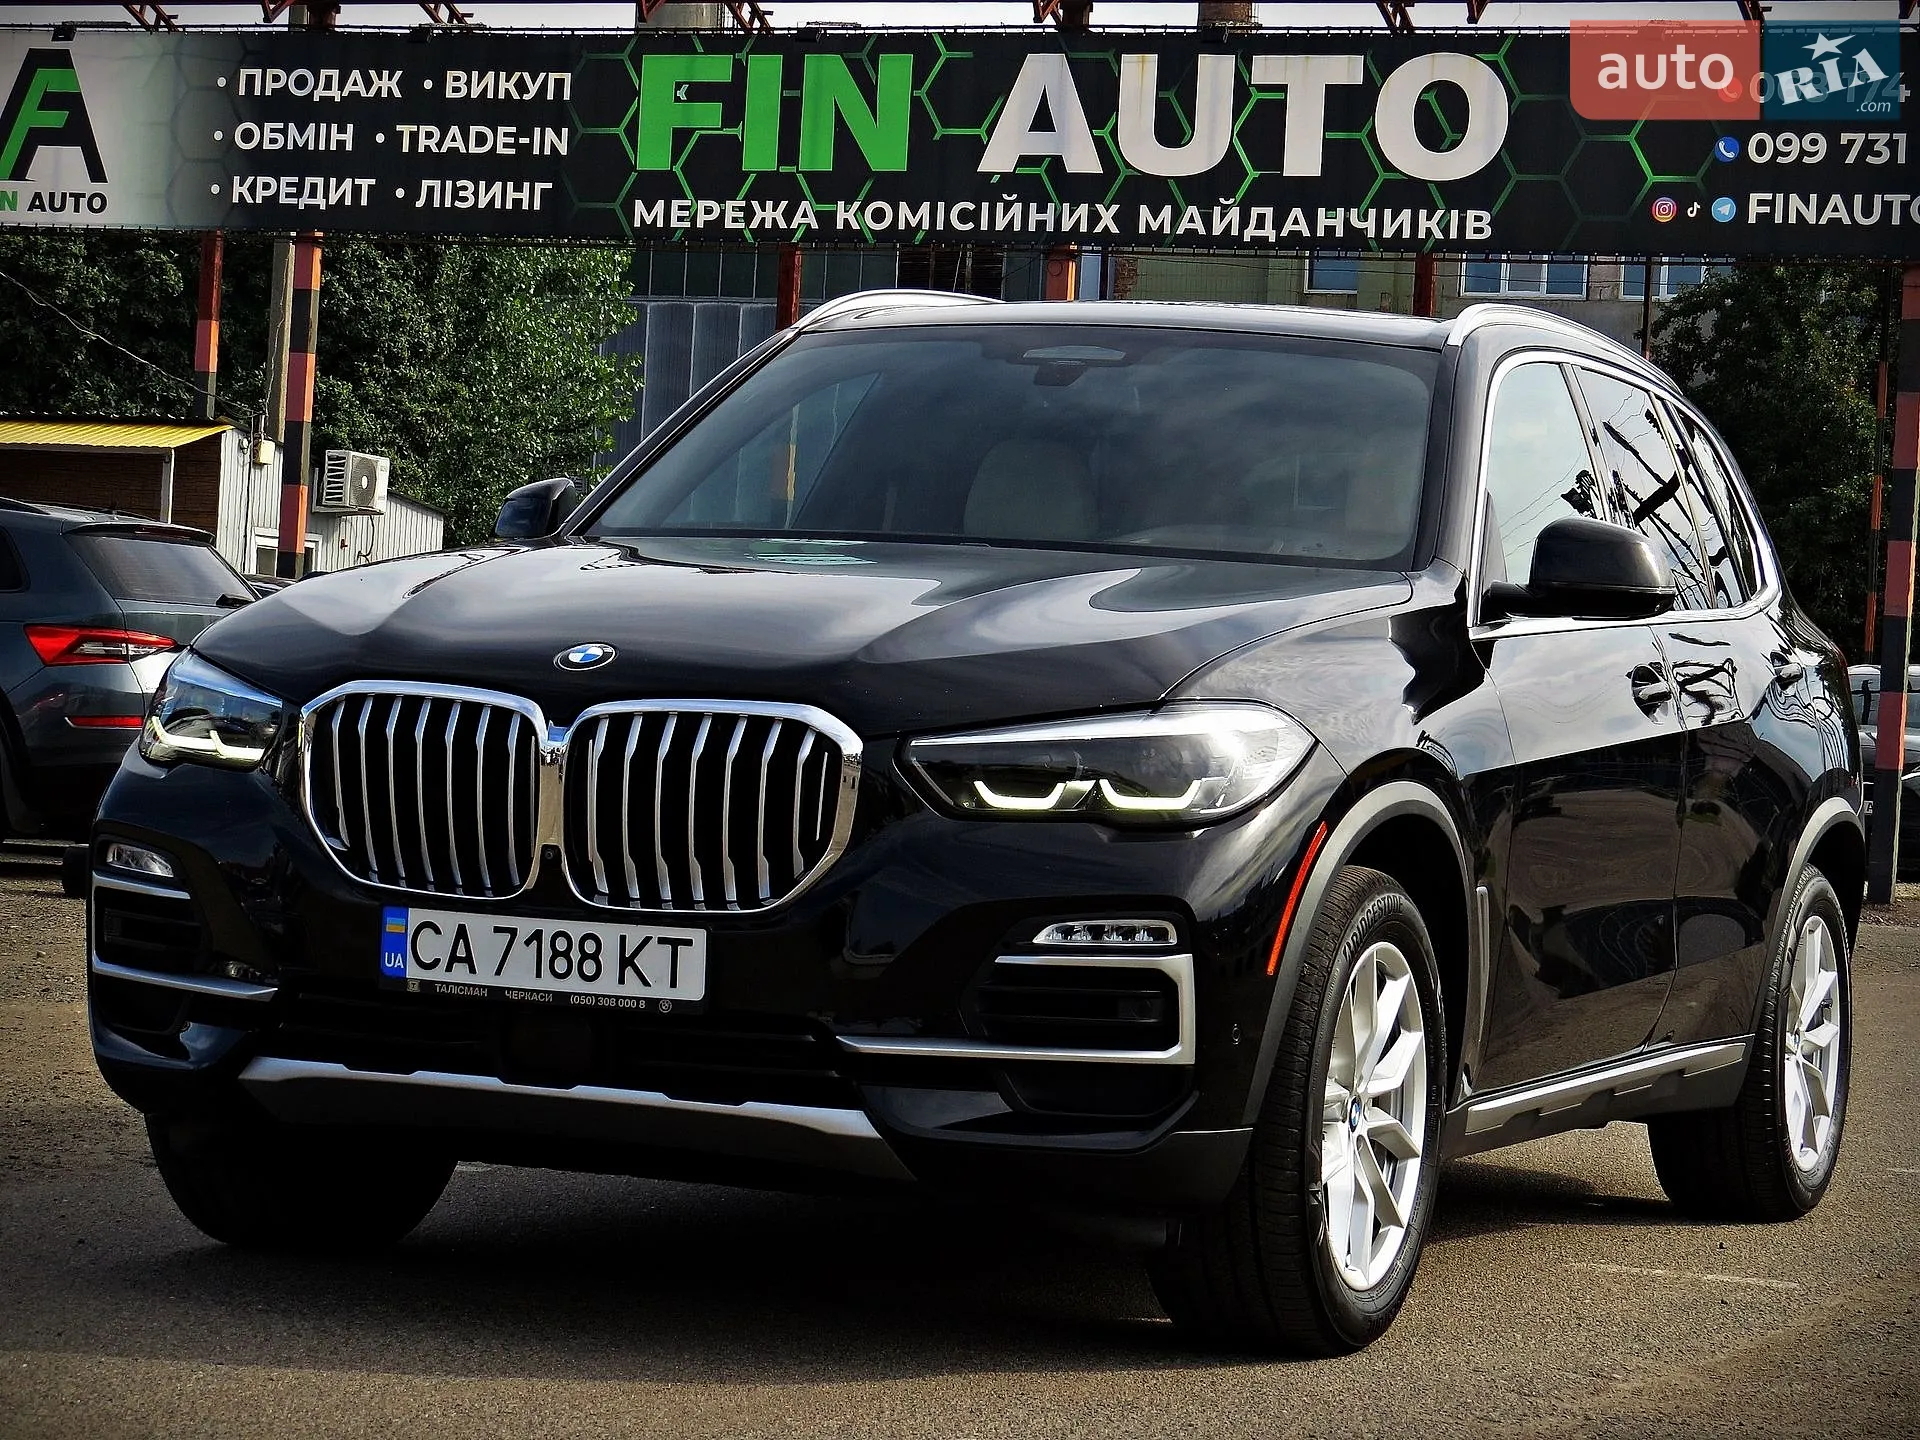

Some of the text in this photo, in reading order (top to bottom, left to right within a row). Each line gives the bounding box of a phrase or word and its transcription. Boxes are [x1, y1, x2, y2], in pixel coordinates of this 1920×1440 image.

[237, 68, 573, 102] ПРОДАЖ ВИКУП
[636, 52, 1509, 182] FIN AUTO
[234, 122, 354, 152] ОБМІН
[396, 124, 569, 156] TRADE-IN
[1748, 132, 1907, 164] 099 731
[26, 191, 108, 214] AUTO
[231, 175, 553, 210] КРЕДИТ ЛІЗИНГ
[633, 194, 1493, 242] МЕРЕЖА КОМІСІЙНИХ МАЙДАНЧИКІВ
[384, 953, 405, 969] UA
[492, 925, 603, 984] 7188
[434, 983, 553, 1002] ТАЛІСМАН ЧЕРКАСИ
[570, 994, 595, 1006] (050)
[597, 997, 616, 1007] 308
